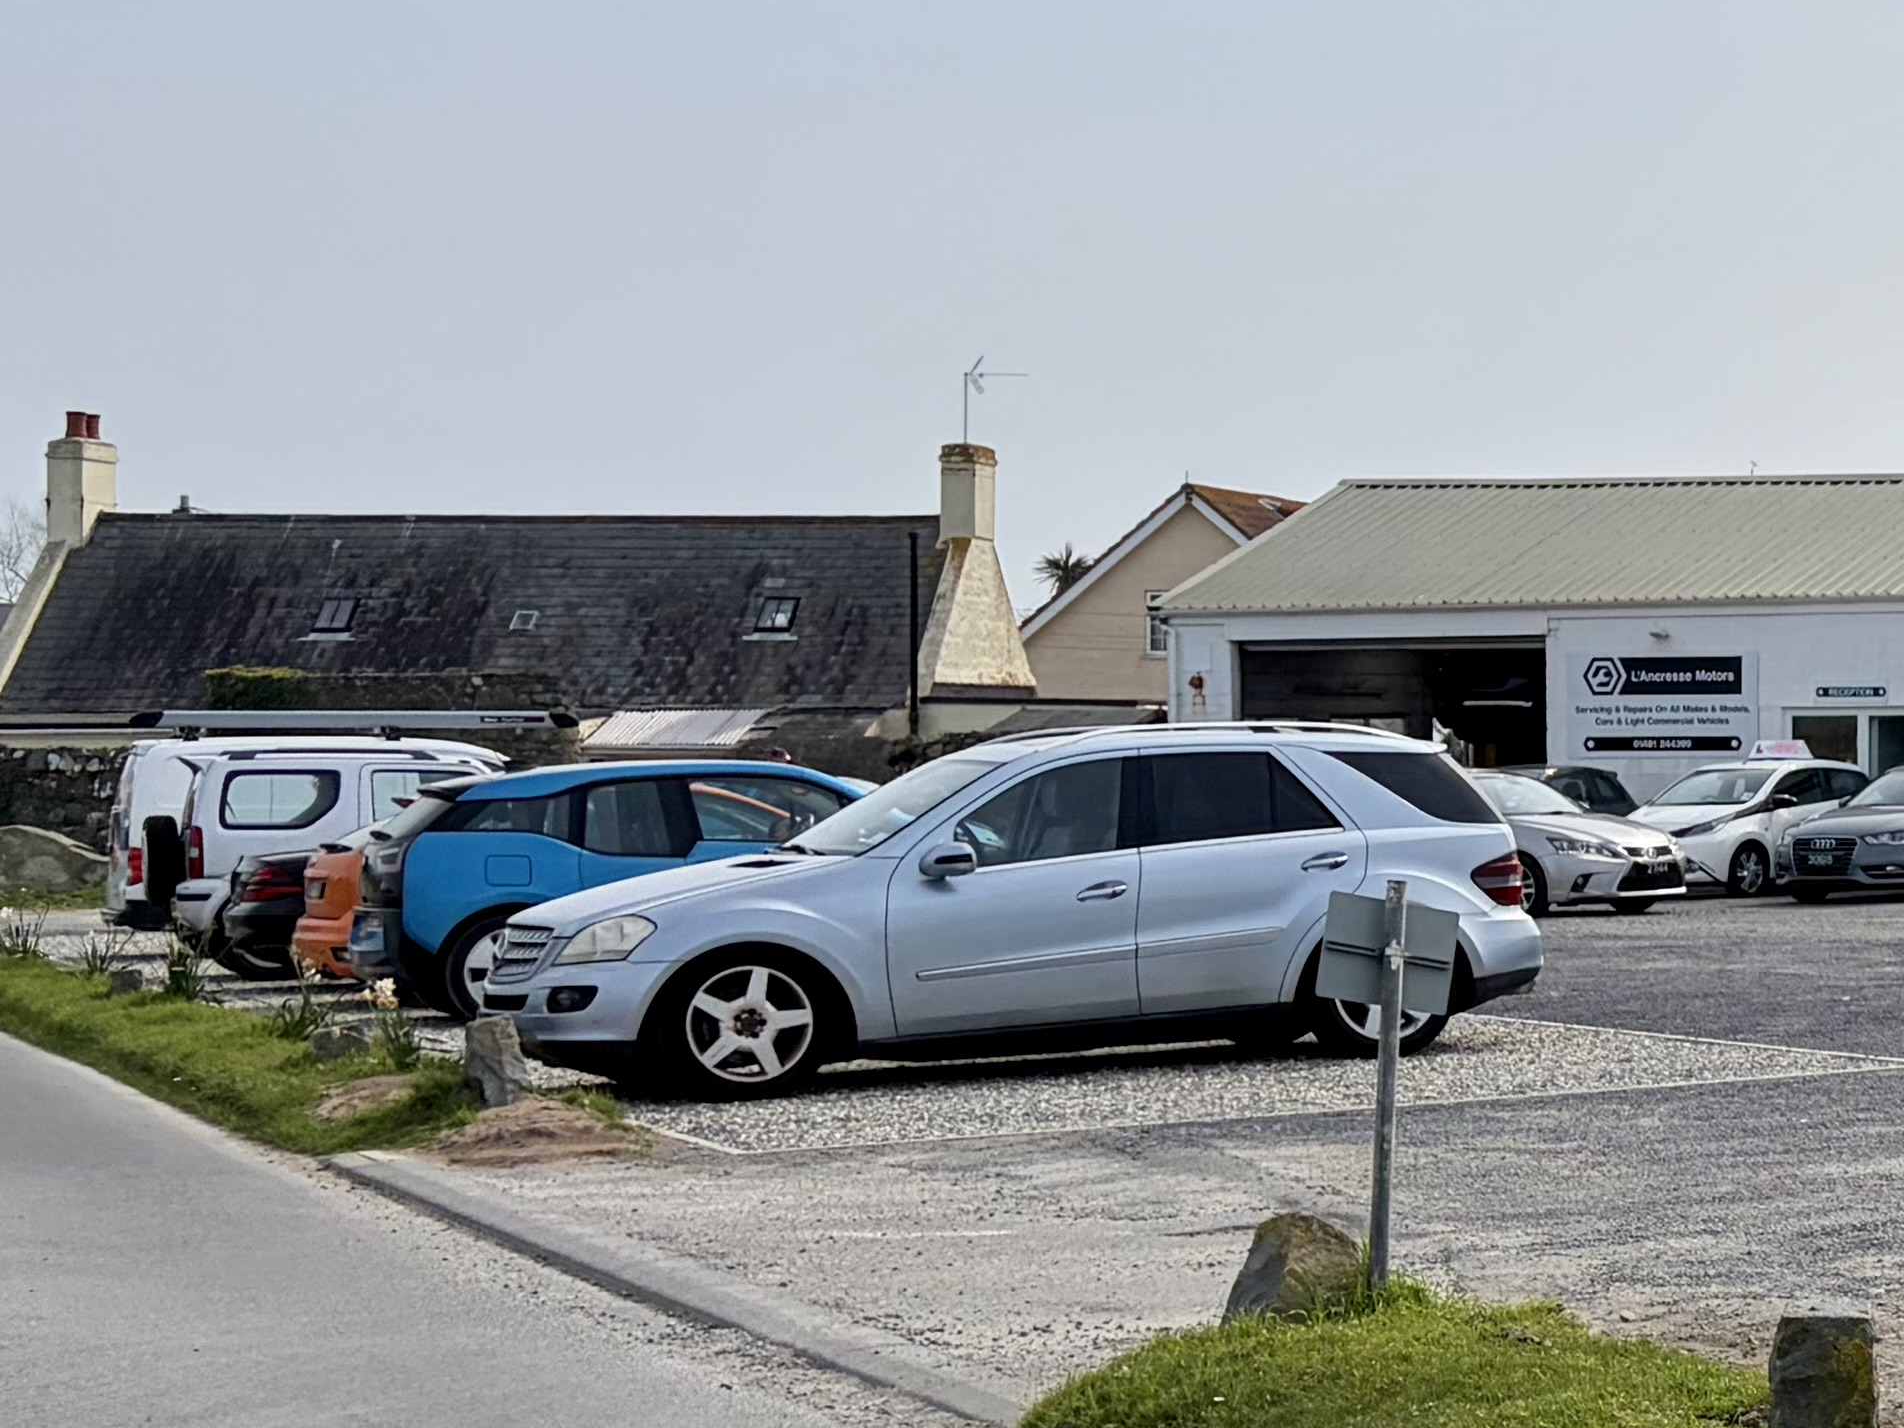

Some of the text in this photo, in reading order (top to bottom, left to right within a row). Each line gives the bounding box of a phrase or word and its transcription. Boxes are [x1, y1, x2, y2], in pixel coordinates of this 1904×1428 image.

[1631, 669, 1735, 682] L'Ancresse Motors
[1828, 687, 1874, 697] RECEPTION
